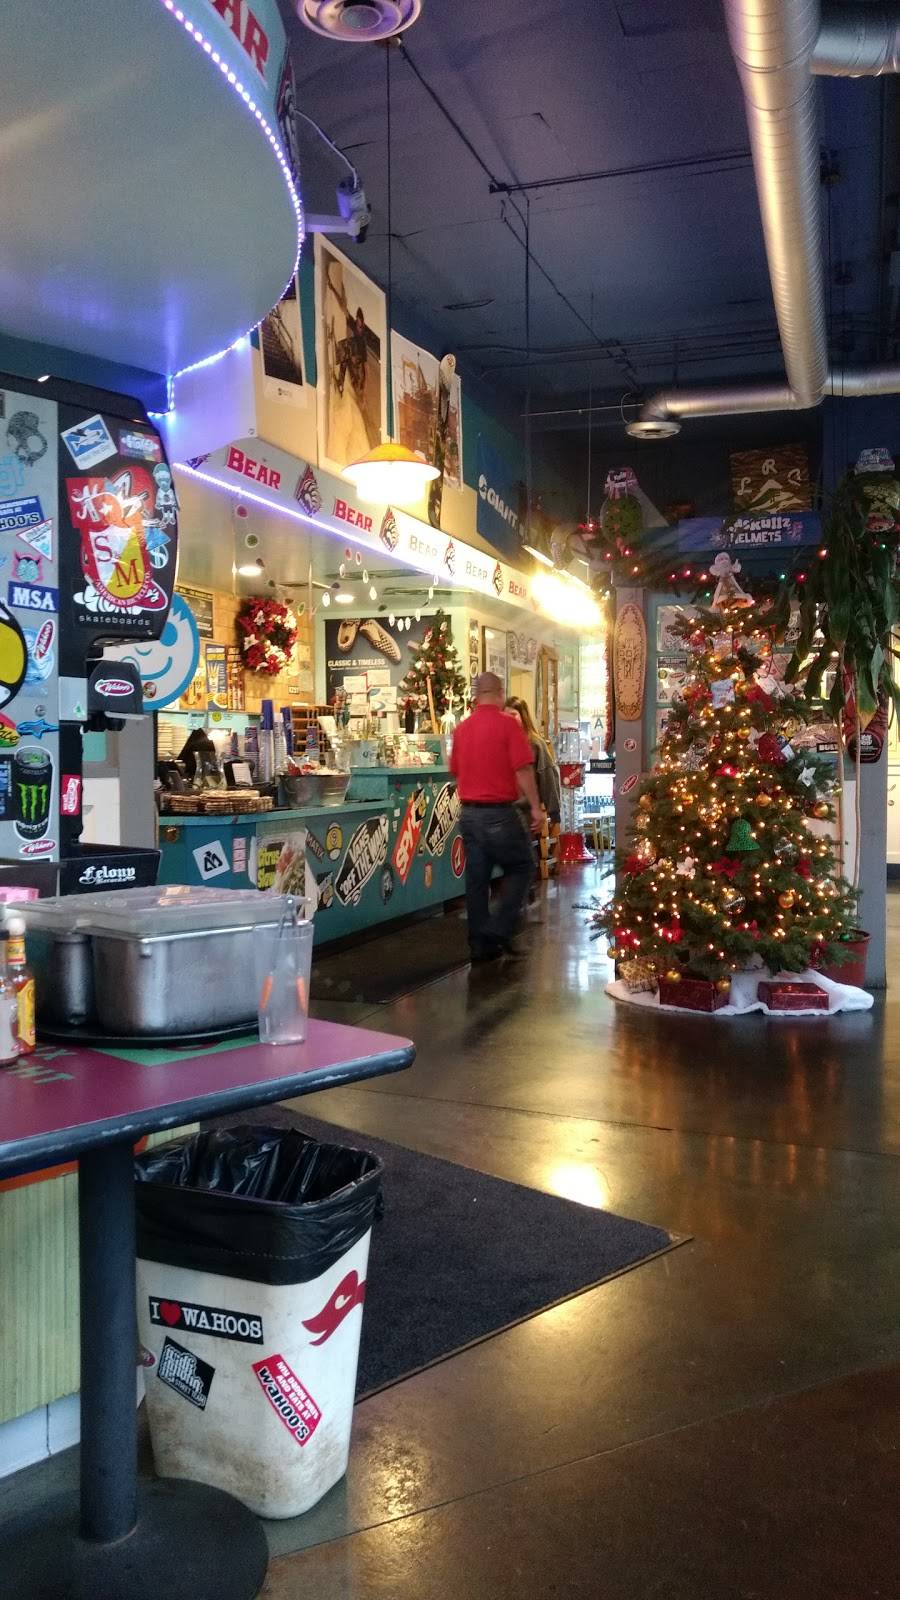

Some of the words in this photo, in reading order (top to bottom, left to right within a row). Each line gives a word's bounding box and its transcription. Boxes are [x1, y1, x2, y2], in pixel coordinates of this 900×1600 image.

[226, 447, 281, 490] BEAR
[334, 498, 373, 533] BEAR
[487, 488, 518, 528] GIANT
[409, 535, 438, 558] BEAR
[465, 560, 488, 581] BEAR
[13, 587, 56, 612] MSA
[79, 615, 151, 627] skateboards
[358, 658, 386, 666] TIMELESS
[348, 824, 370, 861] VANS
[79, 866, 136, 884] Felony
[354, 847, 371, 880] THE
[150, 1301, 161, 1320] I
[182, 1307, 262, 1338] WAHOOS
[259, 1367, 308, 1439] WaHOO'S
[276, 1375, 291, 1392] AND
[288, 1392, 305, 1411] EATS
[301, 1409, 312, 1420] AT
